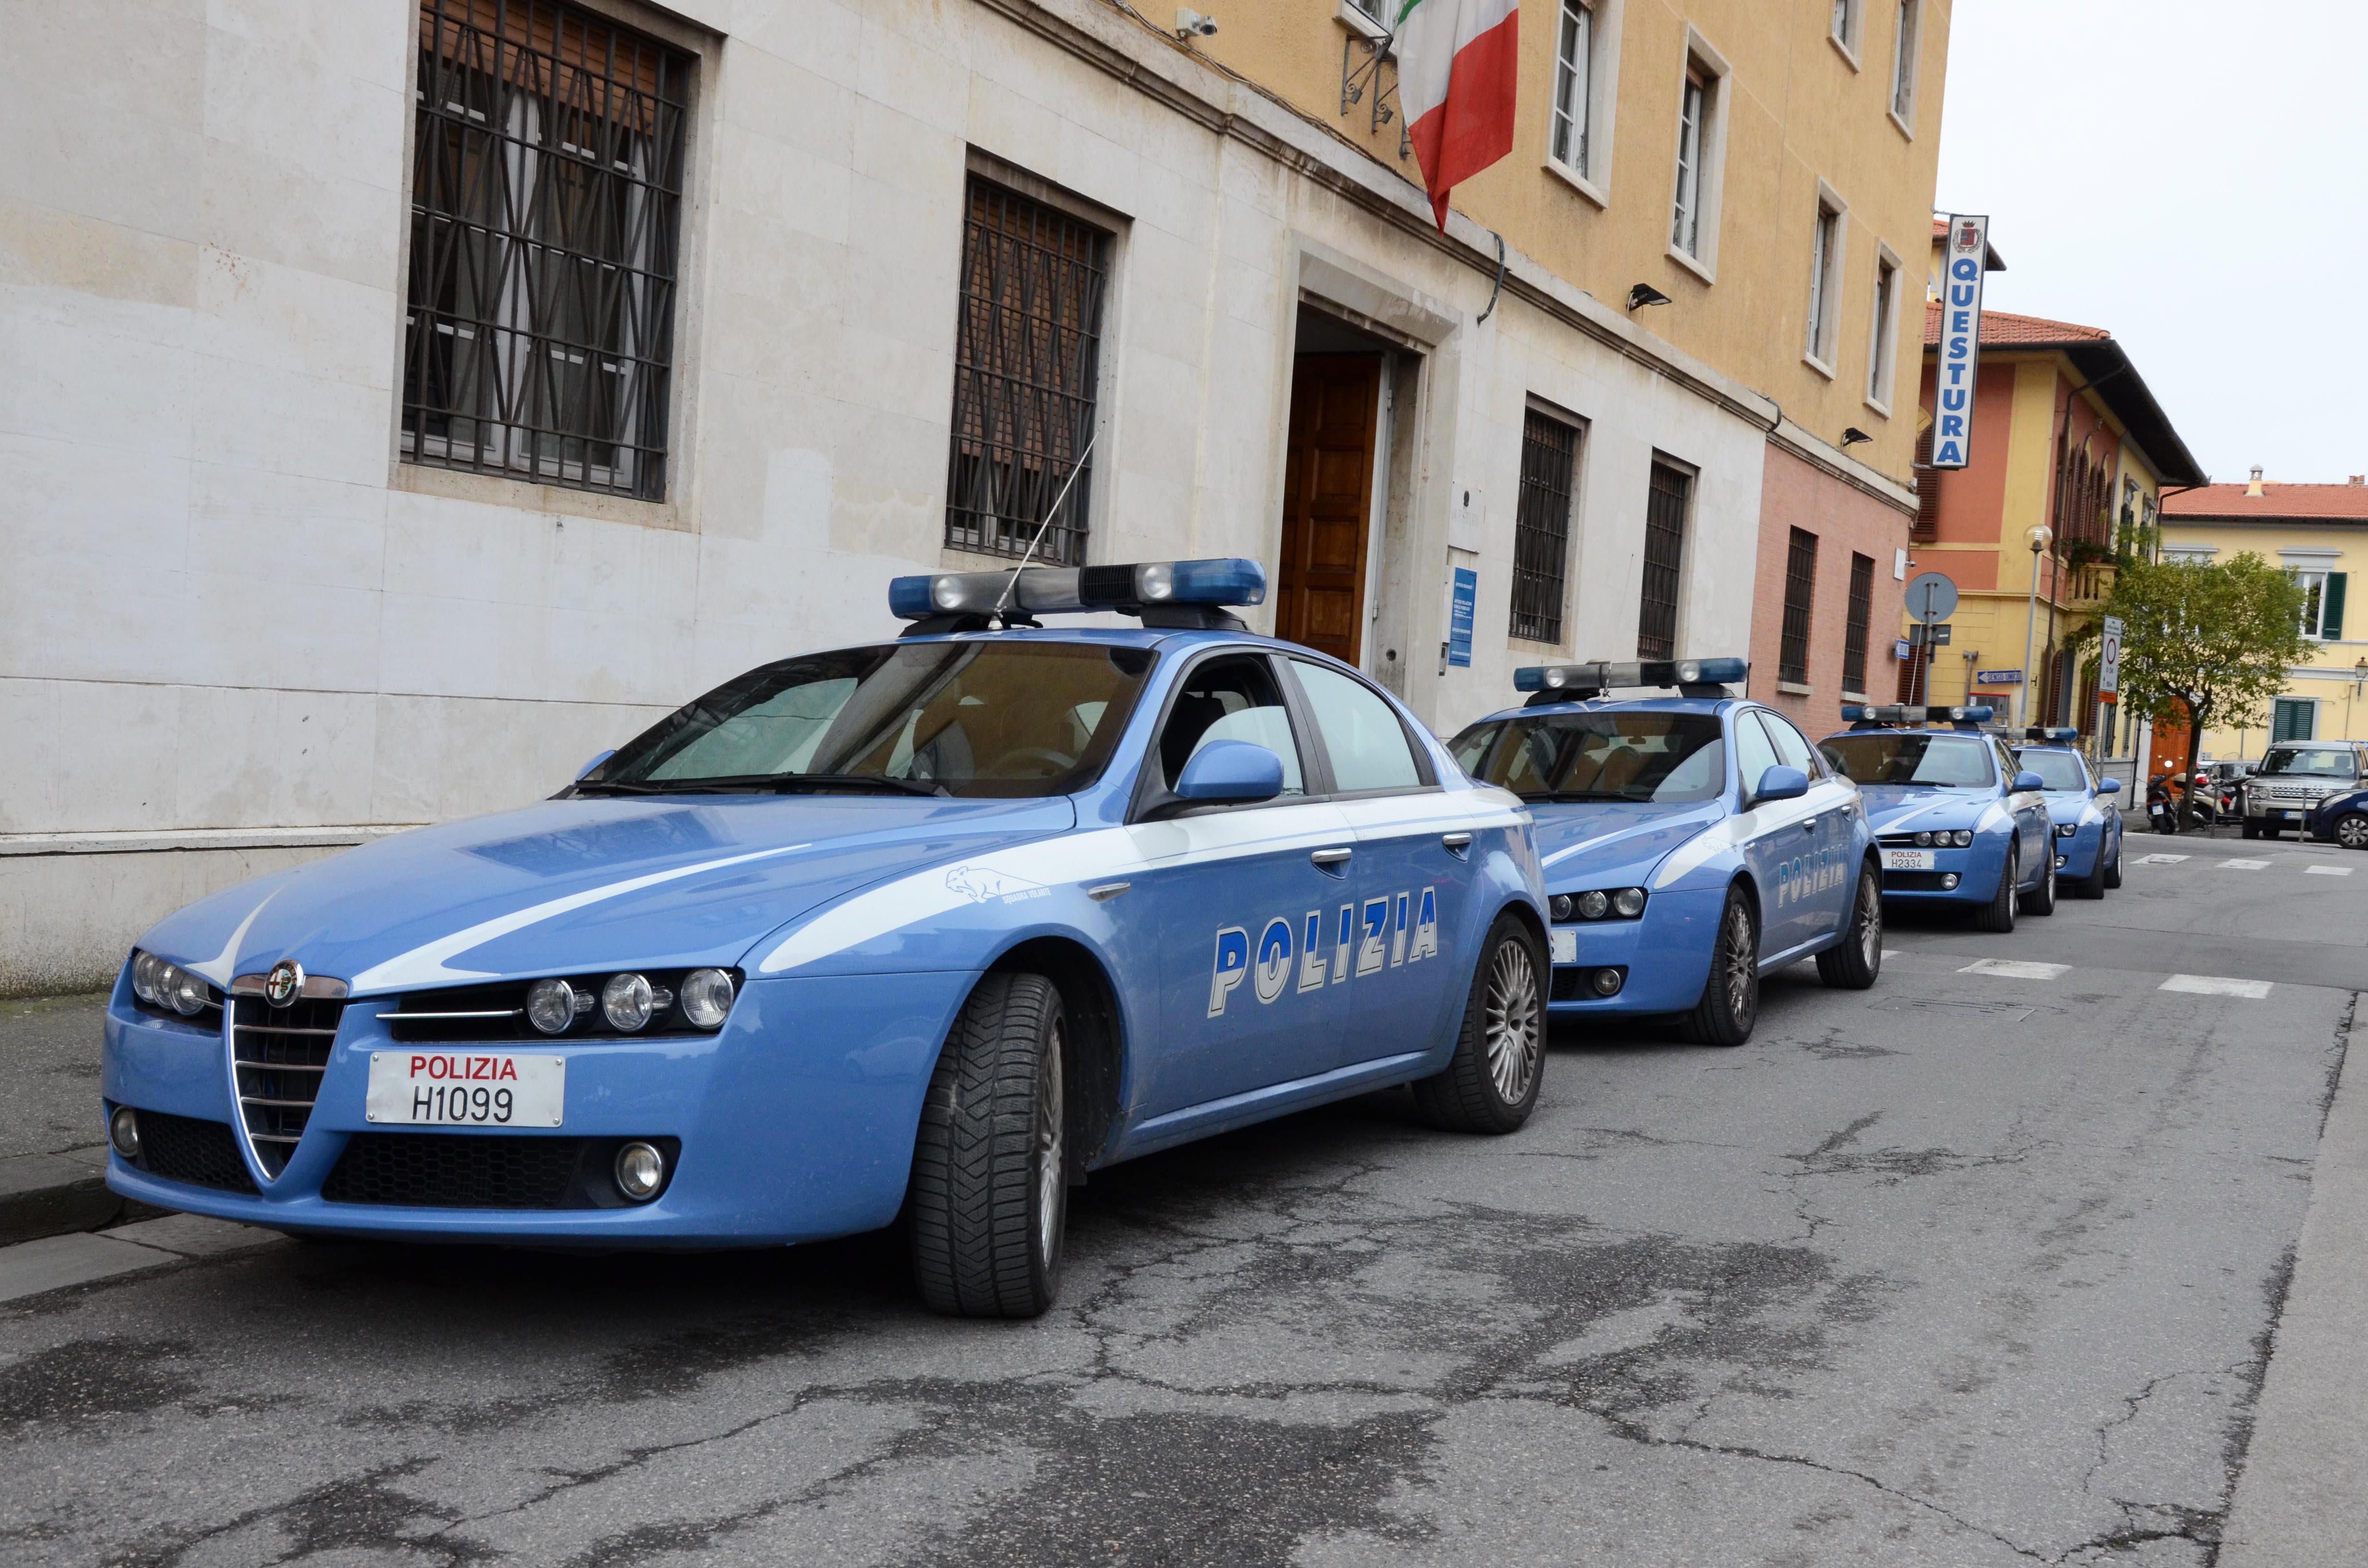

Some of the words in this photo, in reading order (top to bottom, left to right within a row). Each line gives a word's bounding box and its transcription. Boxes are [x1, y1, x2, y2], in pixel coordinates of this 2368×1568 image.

[1936, 258, 1977, 462] QUESTURA
[1778, 844, 1843, 908] POLIZIA
[1891, 859, 1922, 868] H2334
[1002, 892, 1029, 905] SQUADRA
[1027, 887, 1051, 898] VOLANTE
[1207, 885, 1437, 1018] POLIZIA
[410, 1055, 518, 1080] POLIZIA
[412, 1085, 513, 1123] H1099
